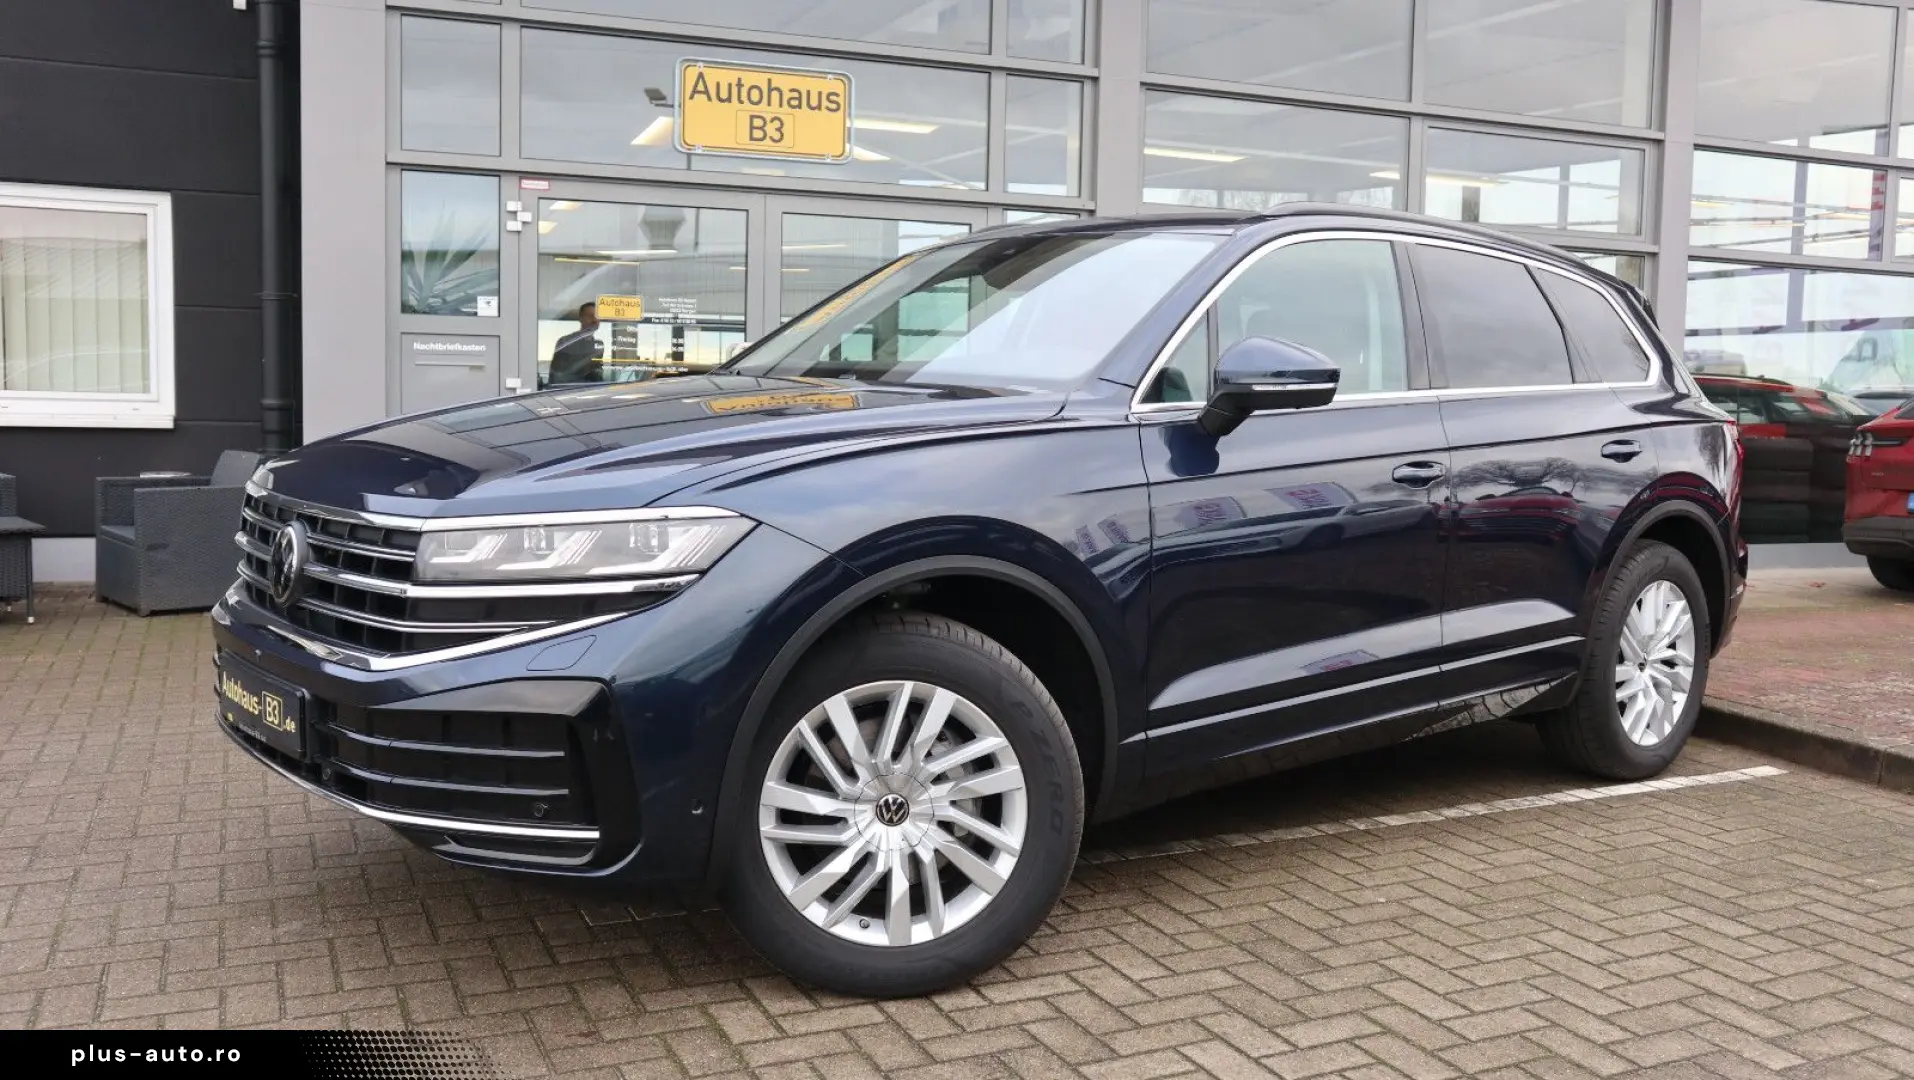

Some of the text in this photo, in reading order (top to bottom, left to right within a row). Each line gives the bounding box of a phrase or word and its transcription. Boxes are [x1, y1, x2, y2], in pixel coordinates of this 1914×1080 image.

[689, 71, 842, 113] Autohaus
[749, 114, 785, 143] B3
[599, 297, 641, 308] Autohaus
[413, 341, 487, 352] Nachtbriefkasten
